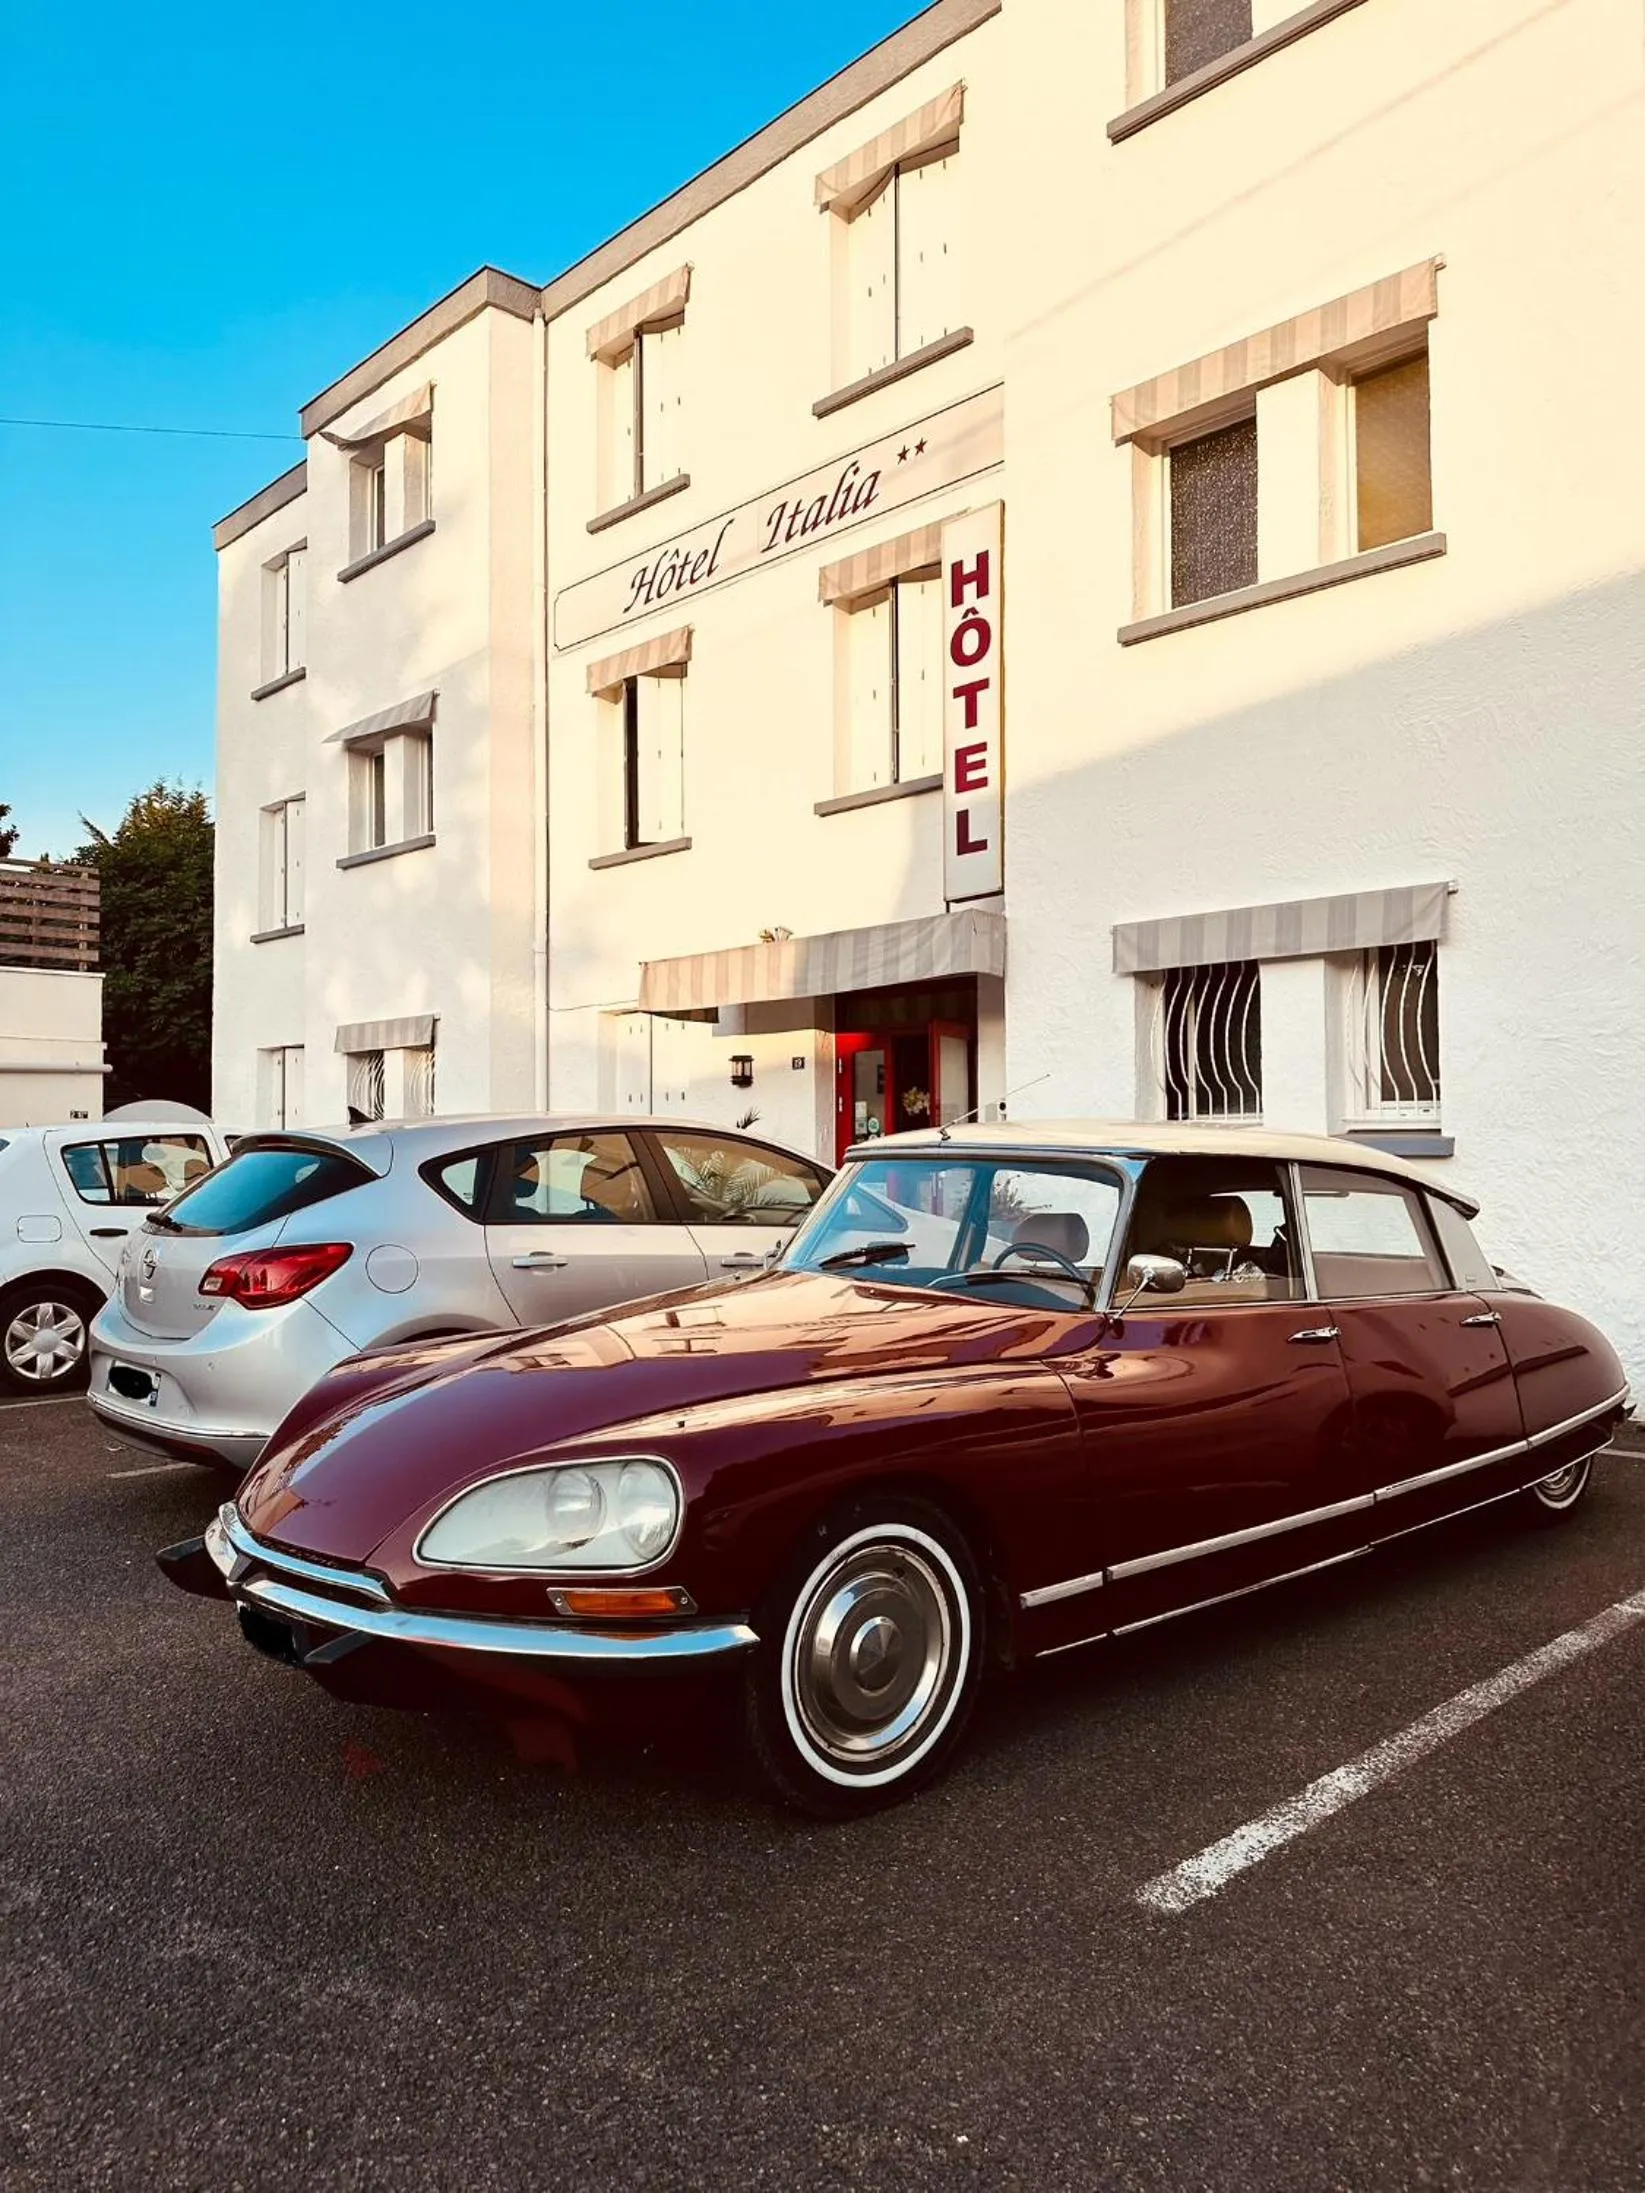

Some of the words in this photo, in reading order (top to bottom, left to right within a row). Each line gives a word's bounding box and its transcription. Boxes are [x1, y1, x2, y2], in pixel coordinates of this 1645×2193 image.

[622, 518, 735, 615] Hôtel
[760, 459, 882, 554] Italia
[950, 549, 992, 856] HÔTEL
